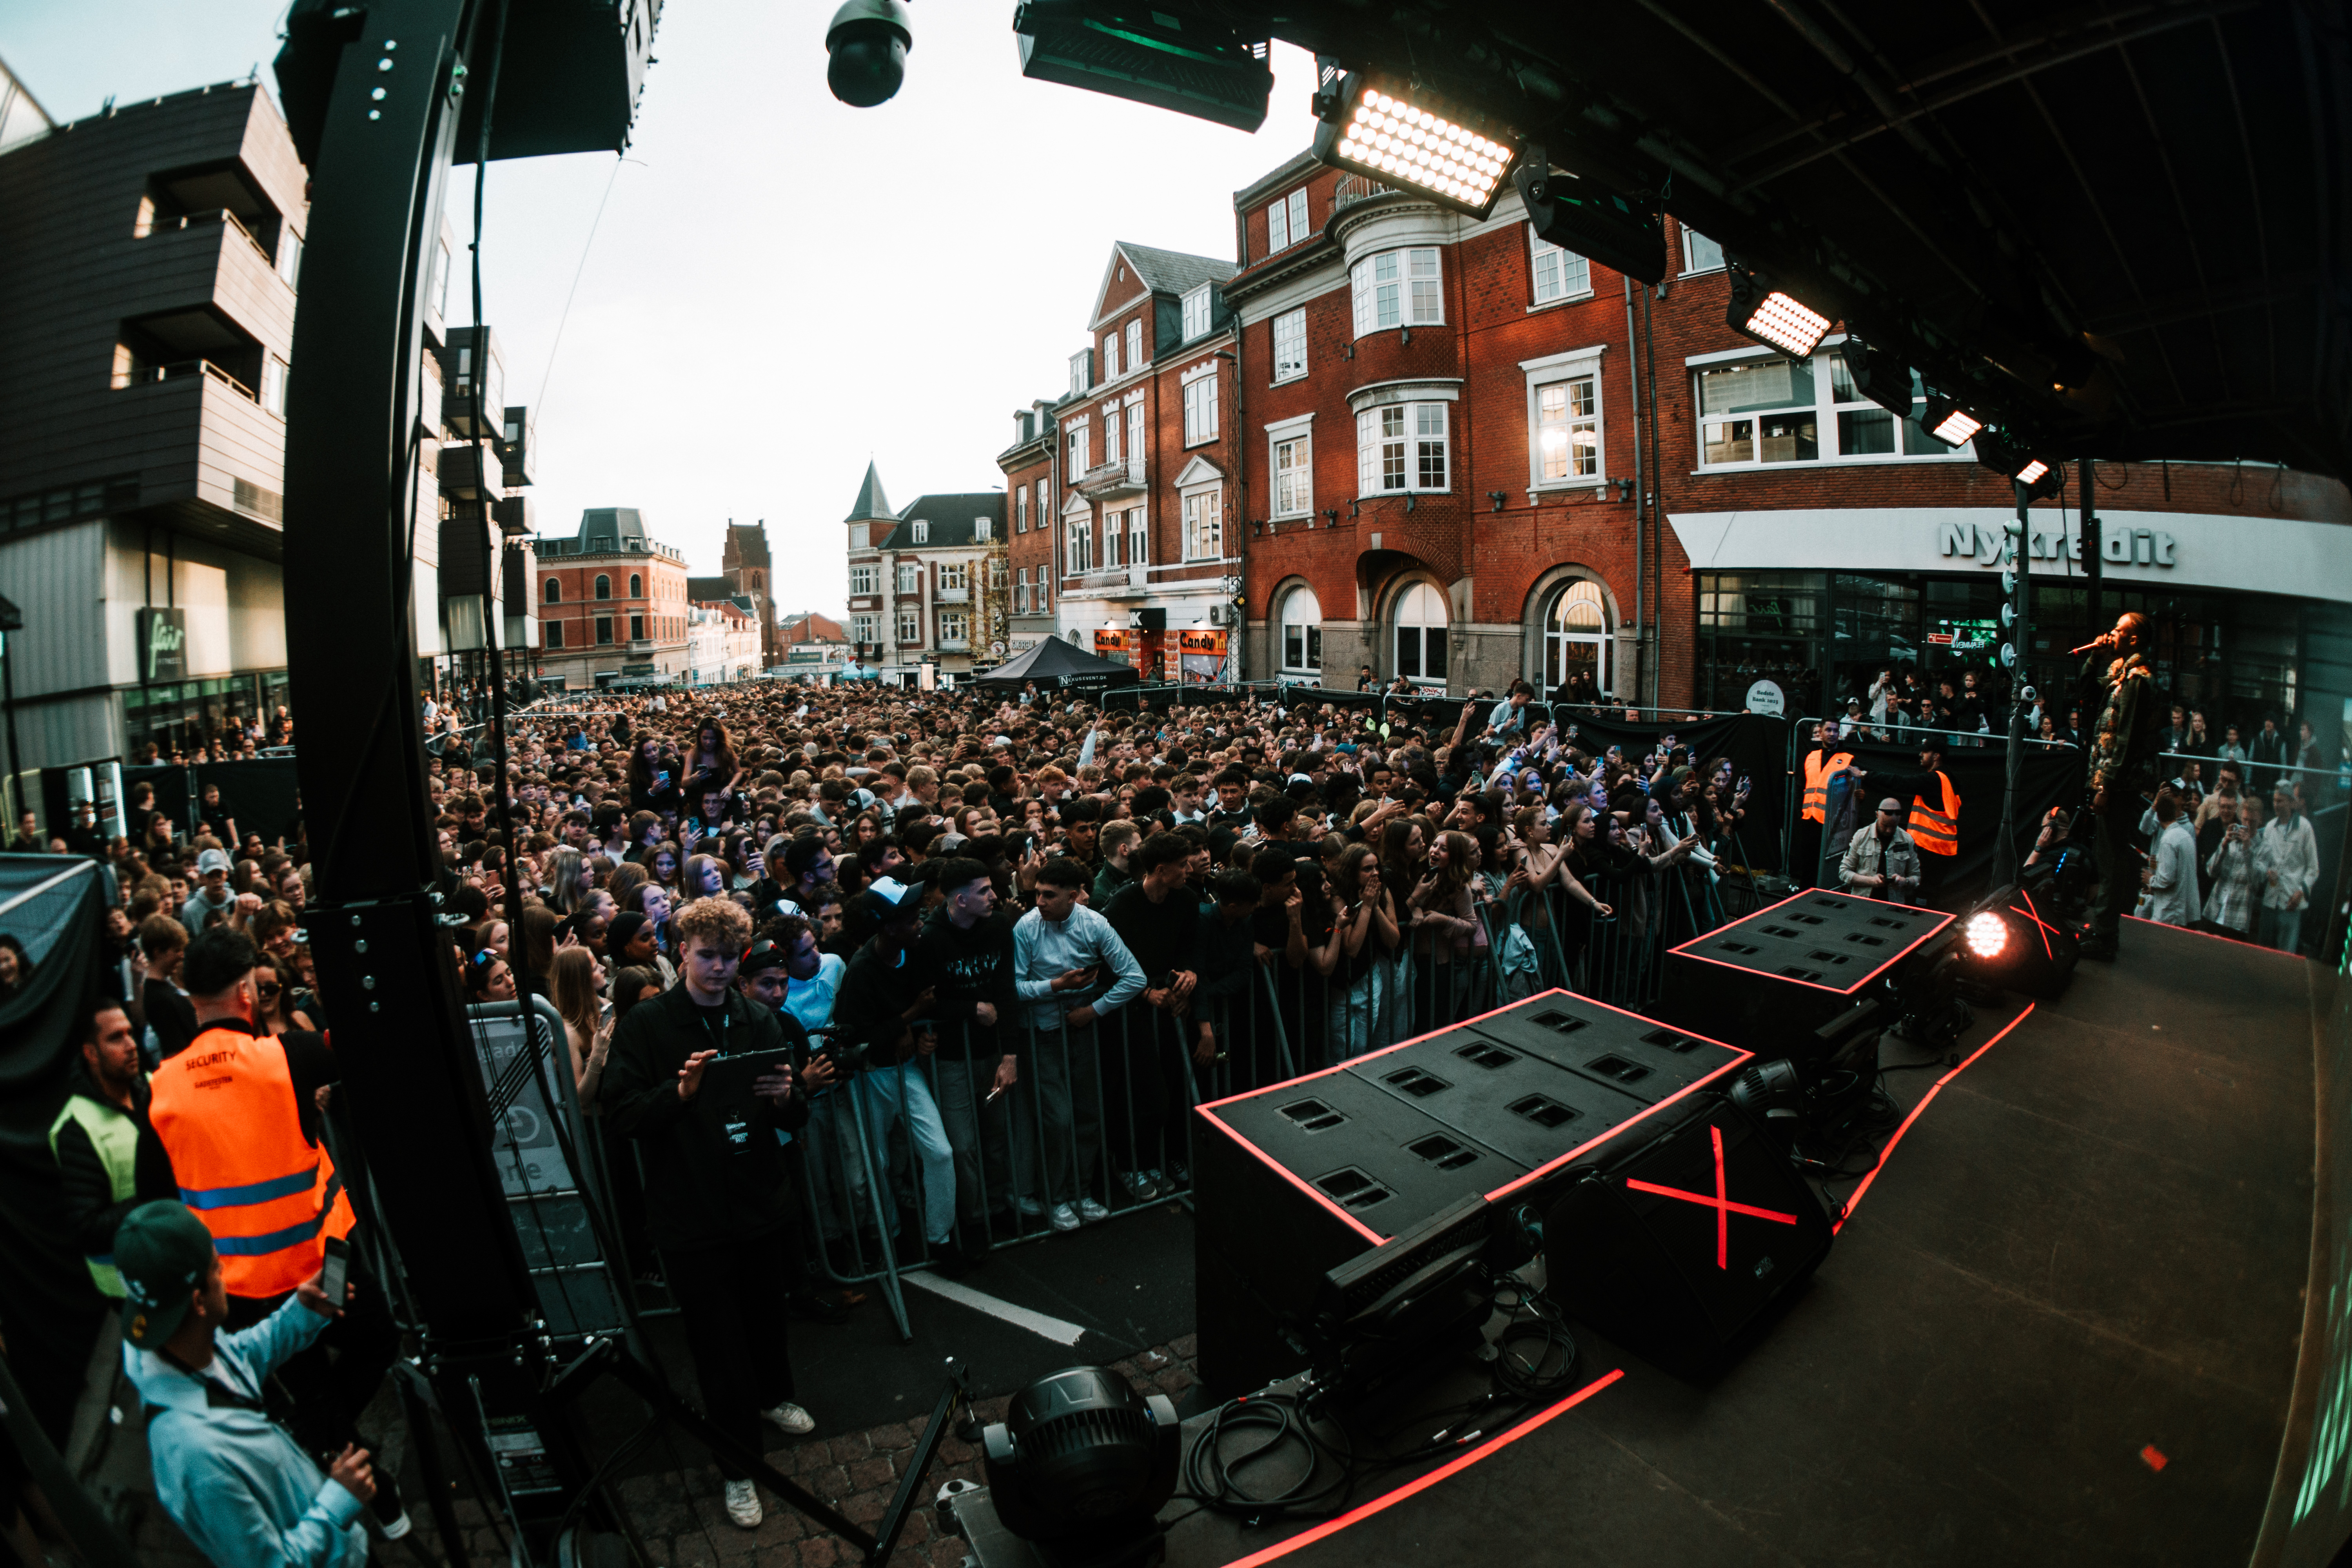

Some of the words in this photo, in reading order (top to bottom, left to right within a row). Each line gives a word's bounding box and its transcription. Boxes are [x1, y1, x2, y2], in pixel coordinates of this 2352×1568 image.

[1095, 632, 1120, 647] Candy
[1180, 632, 1214, 651] Candy
[186, 1051, 236, 1070] SECURITY
